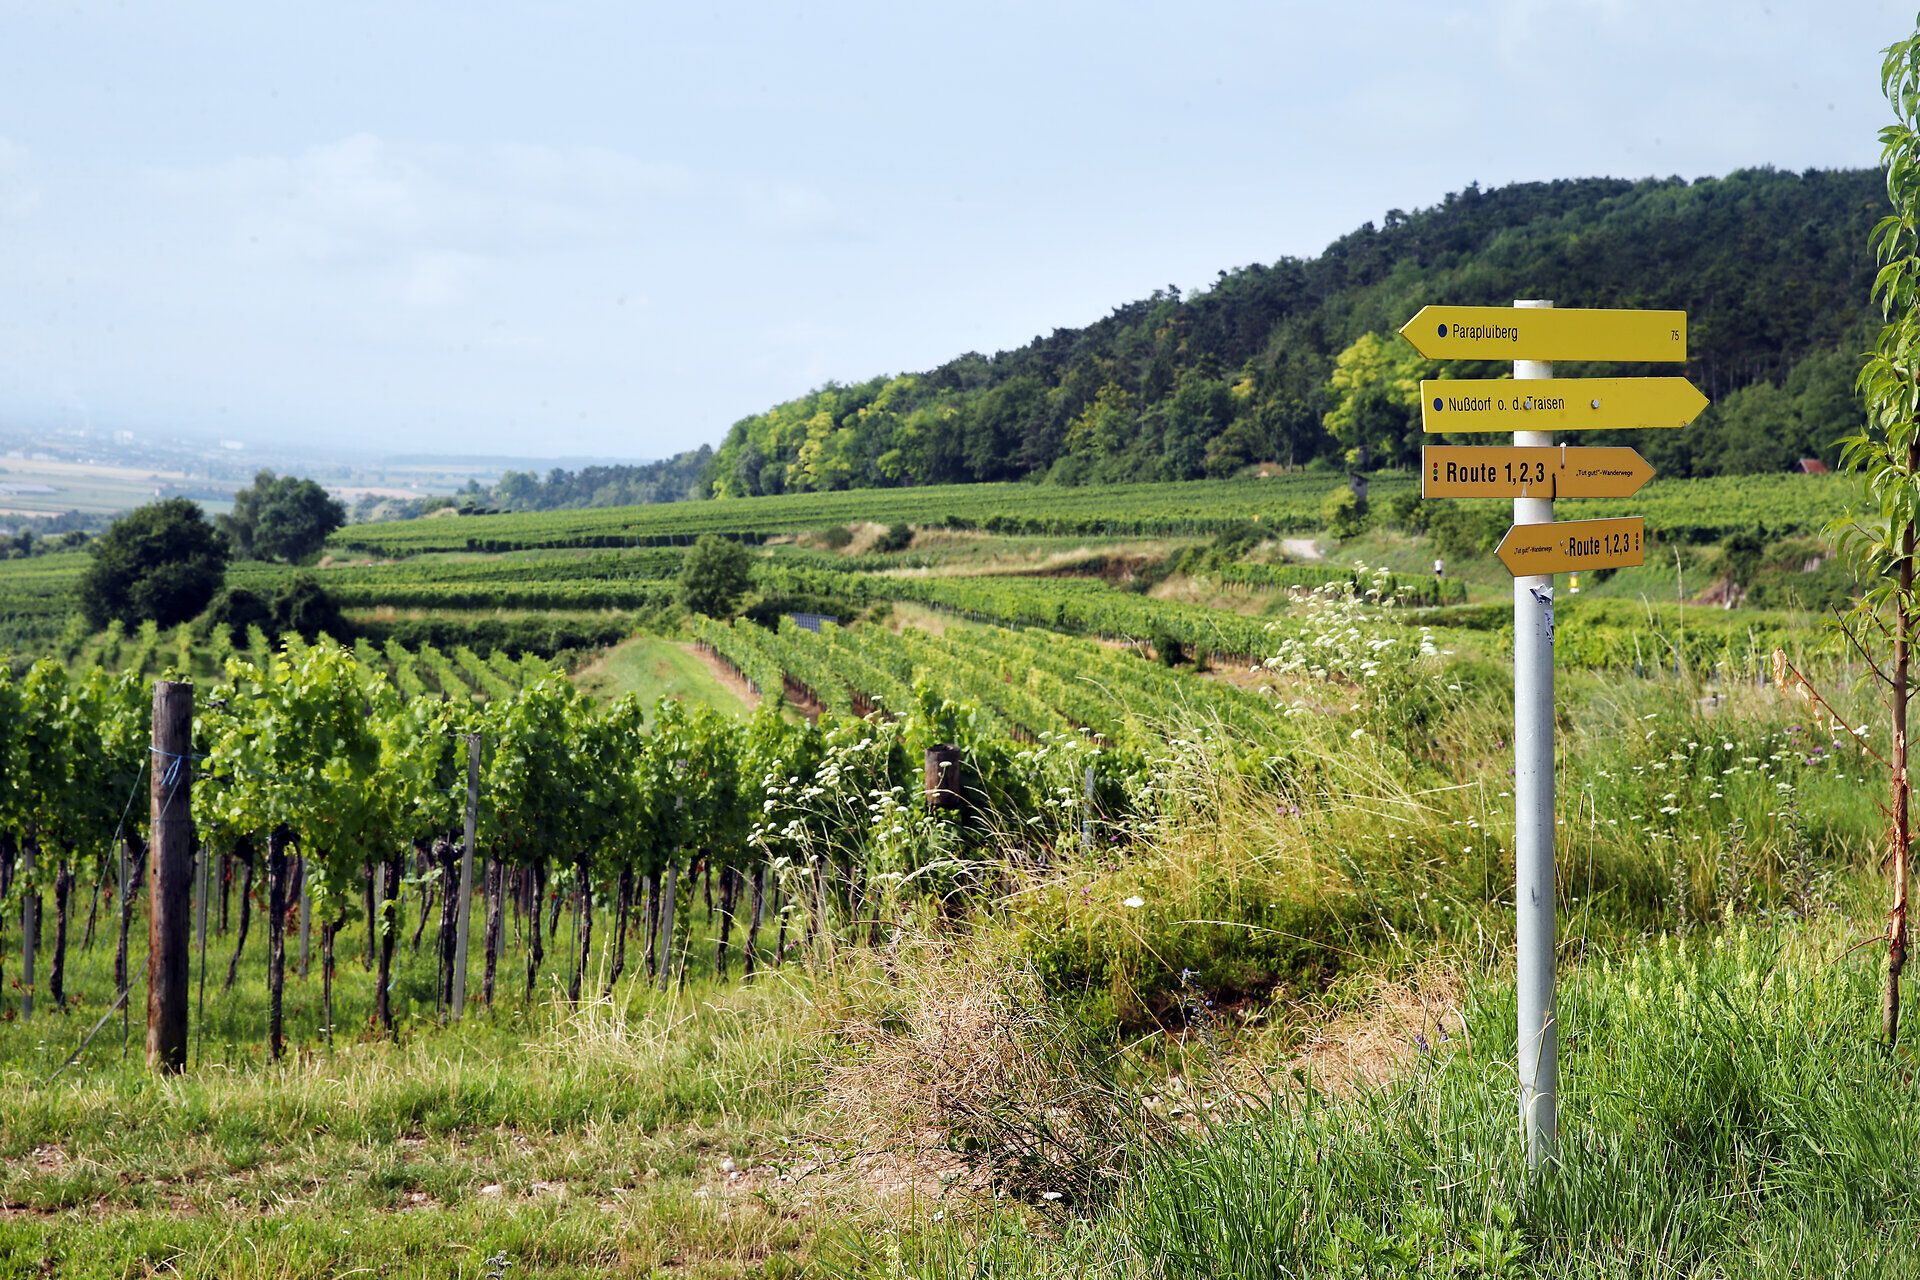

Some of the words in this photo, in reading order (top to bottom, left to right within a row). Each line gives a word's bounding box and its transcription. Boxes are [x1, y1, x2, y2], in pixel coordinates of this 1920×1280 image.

[1453, 323, 1518, 342] Parapluiberg
[1671, 330, 1680, 341] 75
[1448, 397, 1492, 412] Nußdorf
[1498, 399, 1507, 411] o.
[1512, 397, 1522, 411] d.
[1446, 462, 1497, 483] Route
[1504, 462, 1545, 486] 1,2,3
[1569, 536, 1600, 557] Route
[1604, 533, 1630, 556] 1,2,3
